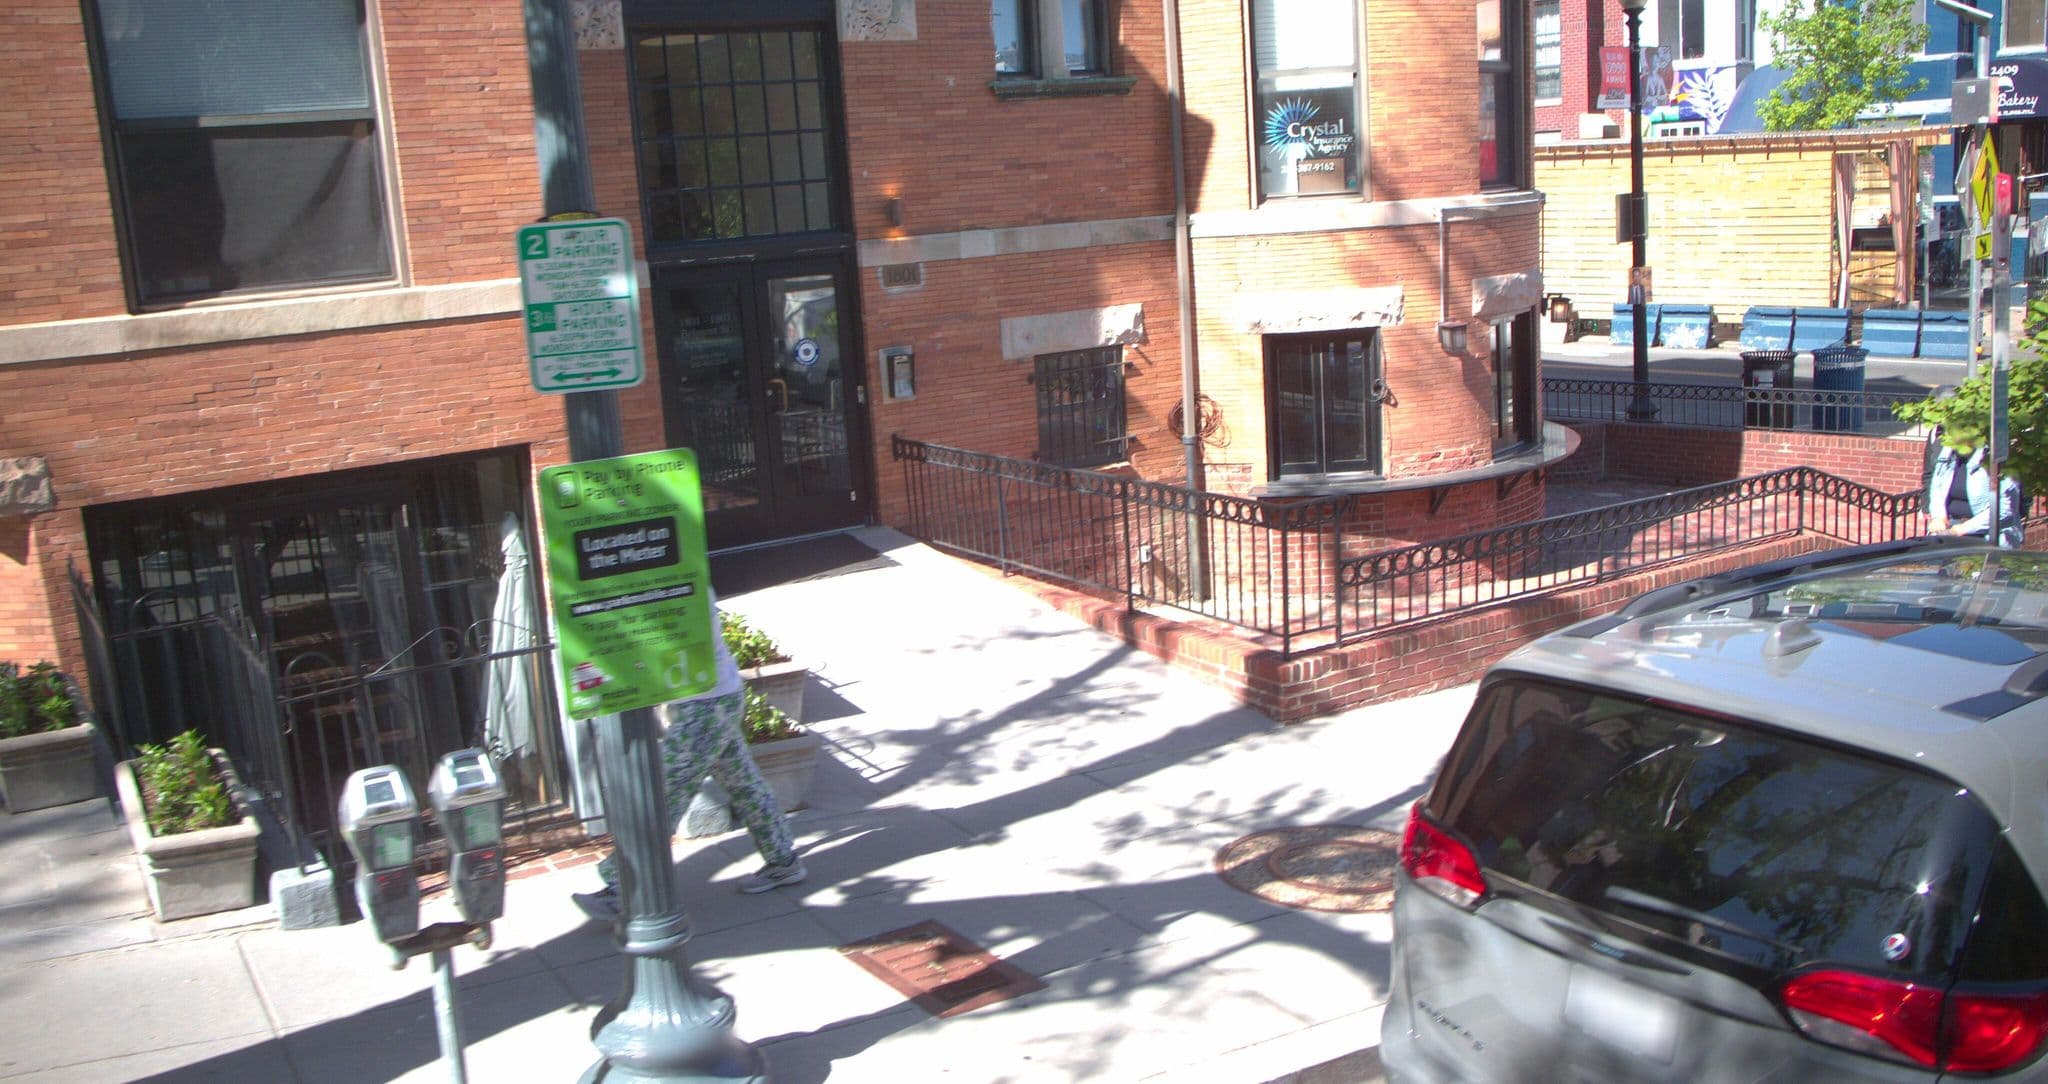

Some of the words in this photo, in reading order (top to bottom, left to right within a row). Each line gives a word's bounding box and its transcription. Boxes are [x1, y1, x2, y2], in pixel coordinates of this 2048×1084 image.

[1990, 65, 2019, 76] 2409
[1998, 92, 2039, 109] Bakery
[1287, 118, 1344, 140] Crystal
[1313, 135, 1353, 145] Insurance
[1317, 143, 1348, 153] Agency
[526, 234, 545, 256] 2
[561, 228, 608, 246] HOUR
[554, 242, 620, 258] PARKING
[570, 300, 615, 315] HOUR
[562, 314, 628, 330] PARKING
[583, 469, 608, 485] Pay
[615, 466, 634, 482] by
[637, 458, 687, 475] Phone
[583, 481, 645, 501] Parking
[581, 528, 646, 553] Located
[647, 525, 670, 543] on
[588, 552, 619, 570] the
[619, 544, 669, 567] Meter
